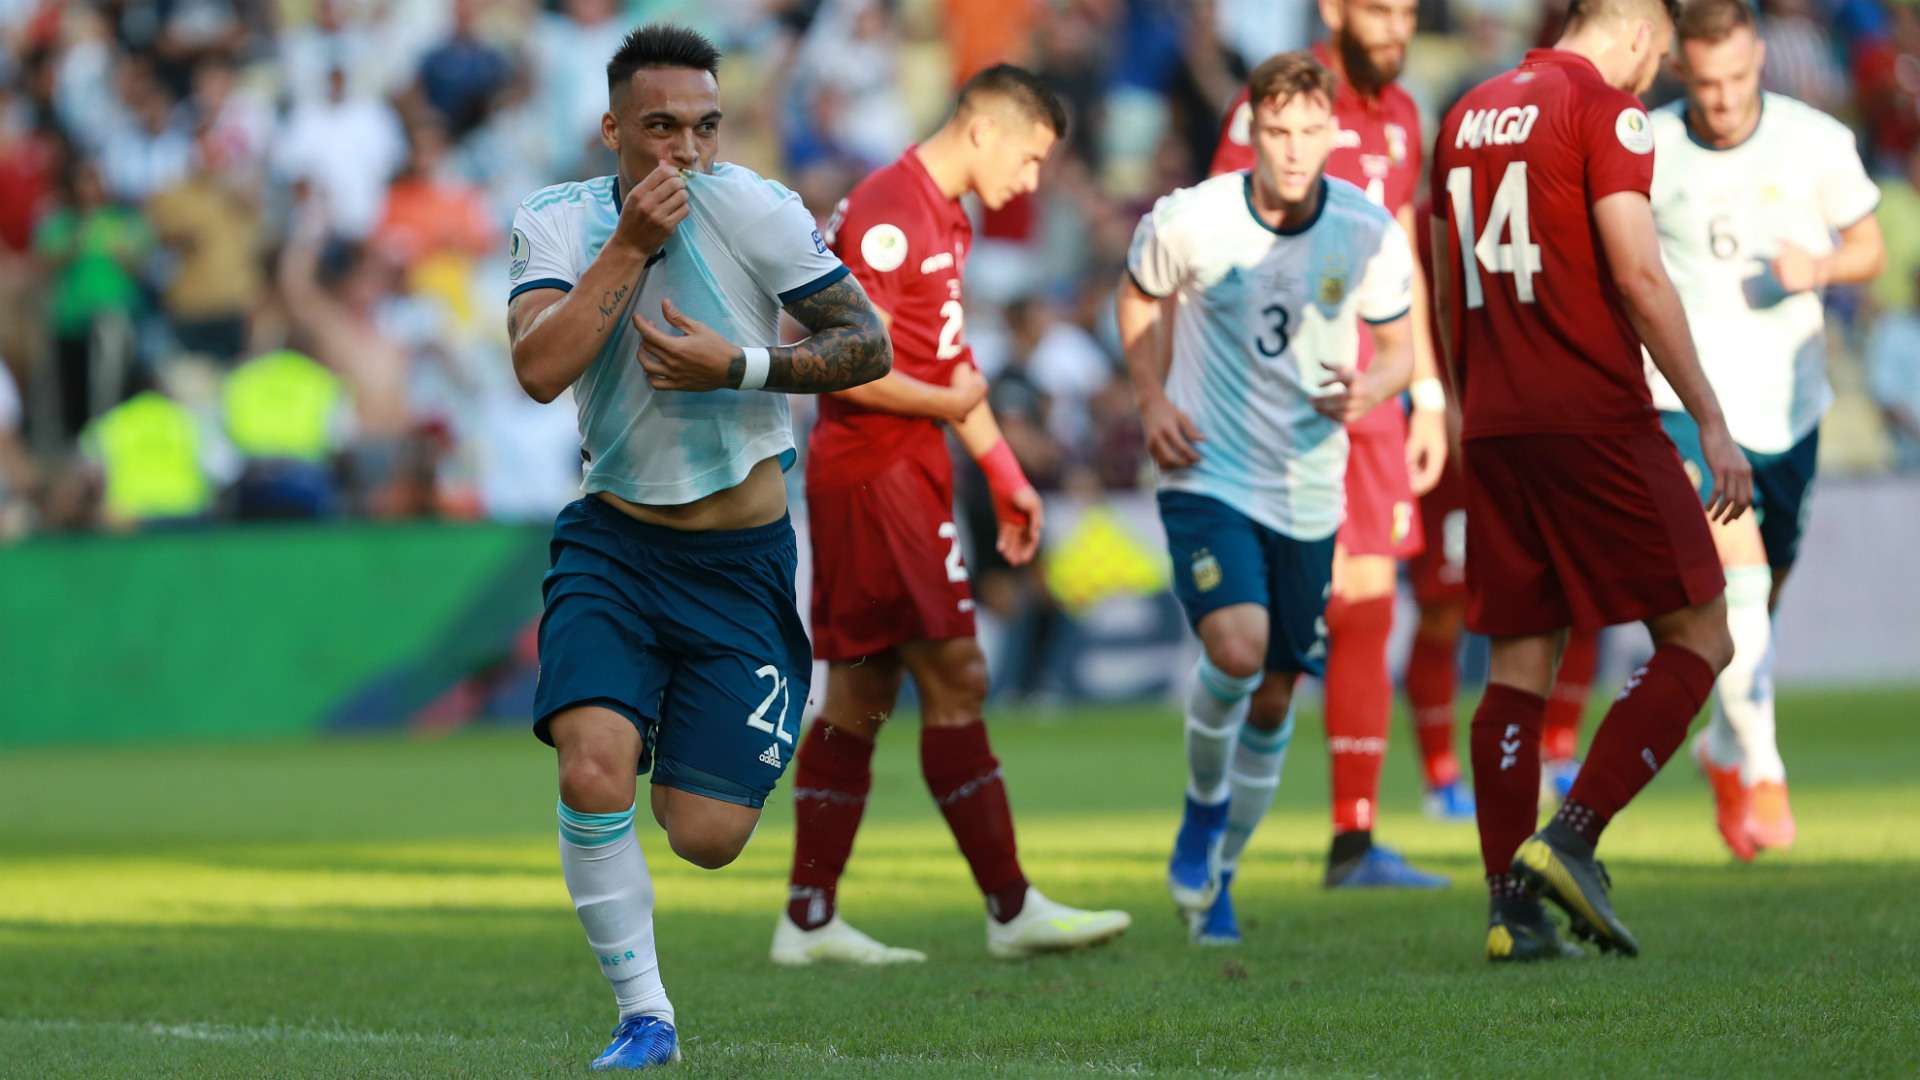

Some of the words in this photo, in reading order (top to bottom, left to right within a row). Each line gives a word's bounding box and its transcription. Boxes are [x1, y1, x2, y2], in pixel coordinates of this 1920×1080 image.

[1455, 104, 1540, 149] MAGO
[1446, 160, 1542, 309] 14
[1707, 213, 1739, 261] 6
[1255, 302, 1290, 358] 3
[745, 664, 793, 745] 22
[758, 753, 782, 769] adidas
